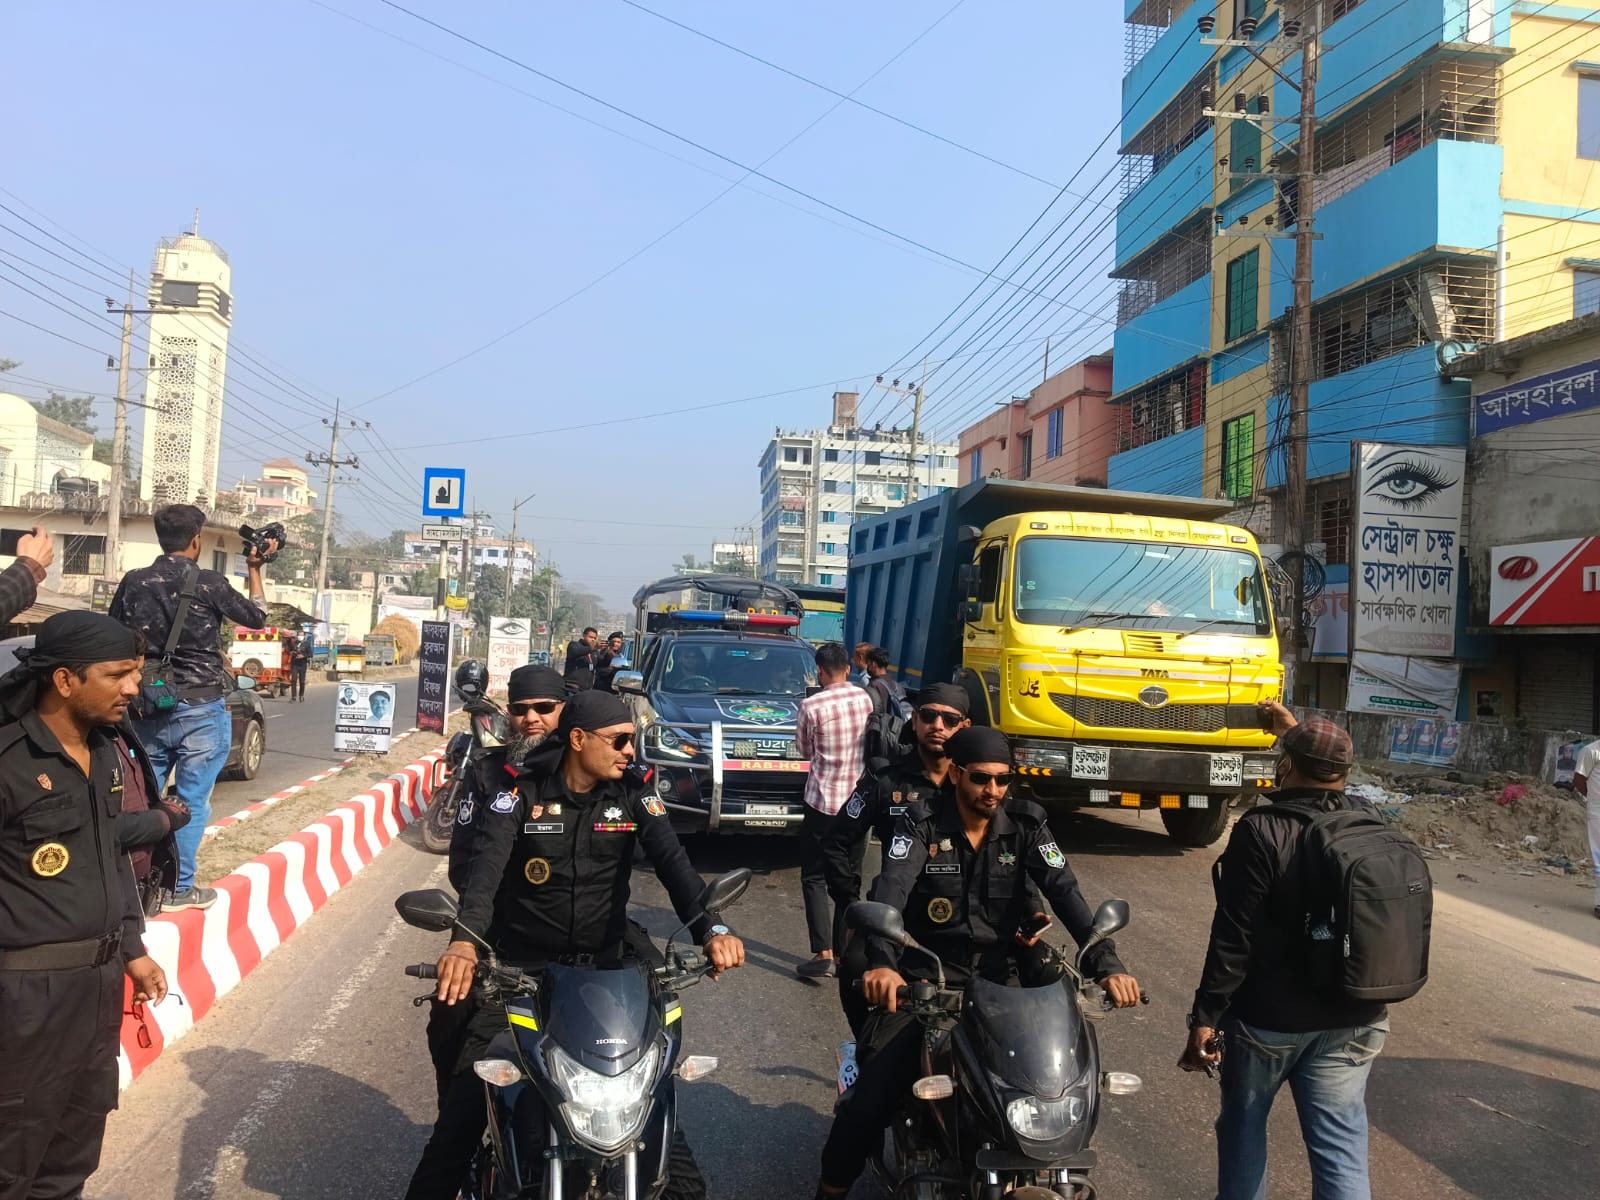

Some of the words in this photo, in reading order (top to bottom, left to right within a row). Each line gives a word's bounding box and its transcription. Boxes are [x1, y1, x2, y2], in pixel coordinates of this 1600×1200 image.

[1362, 517, 1420, 557] সেন্ট্রাল
[1425, 529, 1456, 565] চক্ষু
[1362, 559, 1454, 595] হাসপাতাল
[1361, 595, 1417, 622] সার্বক্ষণিক
[1421, 603, 1452, 625] খোলা
[1140, 668, 1169, 678] TATA
[741, 761, 801, 770] RAB-HQ
